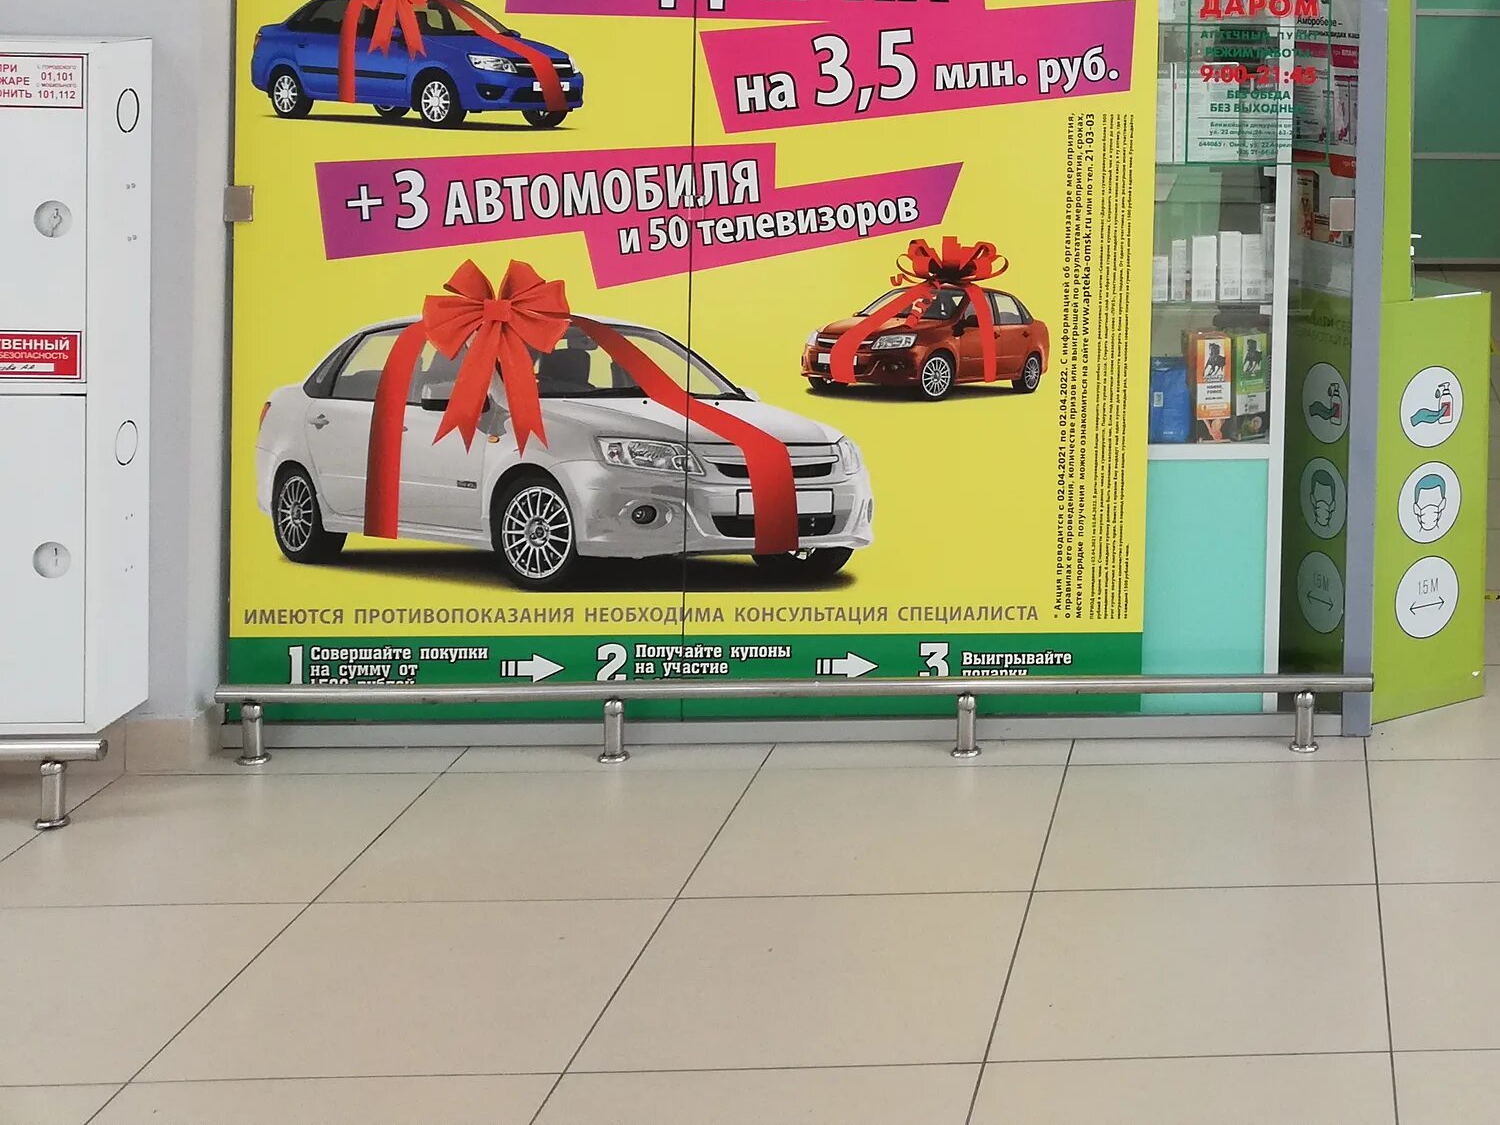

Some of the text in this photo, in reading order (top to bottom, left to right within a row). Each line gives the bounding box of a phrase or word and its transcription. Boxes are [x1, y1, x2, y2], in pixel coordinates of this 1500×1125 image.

[1200, 30, 1270, 40] АПТЕЧНЫЙ
[1205, 47, 1252, 58] РЕЖИМ
[735, 27, 1121, 114] на 3,5 млн. руб.
[0, 89, 32, 99] НИТЬ
[1210, 103, 1231, 113] БЕЗ
[1227, 90, 1291, 100] БЕЗ ОБЕДА
[1066, 113, 1075, 187] мероприятия,
[1085, 113, 1094, 161] 21-03-03
[394, 168, 429, 230] 3
[443, 159, 761, 227] АВТОМОБИЛЯ
[1075, 153, 1083, 221] мероприятия,
[1086, 184, 1092, 195] по
[618, 193, 920, 255] и 50 телевизоров
[1064, 190, 1073, 262] организаторе
[1073, 224, 1081, 284] результатам
[1063, 266, 1070, 278] об
[1082, 218, 1092, 335] www.apteka-omsk.ru
[1073, 288, 1079, 299] по
[1061, 282, 1071, 355] информацией
[1071, 302, 1079, 361] выигрышей
[0, 336, 70, 351] ВЕННЫЙ
[1081, 338, 1089, 363] сайте
[1082, 366, 1088, 376] на
[1059, 368, 1068, 426] 02.04.2022.
[1069, 385, 1077, 419] призов
[1060, 430, 1066, 442] по
[1057, 446, 1066, 501] 02.04.2021
[1066, 481, 1074, 543] проведения,
[1056, 514, 1064, 575] проводится
[1076, 542, 1084, 581] порядке
[1054, 579, 1062, 610] Акция
[1065, 565, 1073, 610] правилах
[243, 605, 1040, 625] ИМЕЮТСЯ ПРОТИВОПОКАЗАНИЯ НЕОБХОДИМА КОНСУЛЬТАЦИЯ СПЕЦИАЛИСТА
[288, 644, 305, 684] 1
[310, 645, 489, 663] Совершайте покупки
[596, 643, 628, 682] 2
[634, 644, 792, 662] Получайте купоны
[634, 660, 729, 677] на участие
[919, 642, 950, 677] 3
[962, 651, 1073, 668] Выигрывайте
[310, 663, 418, 680] на сумму от
